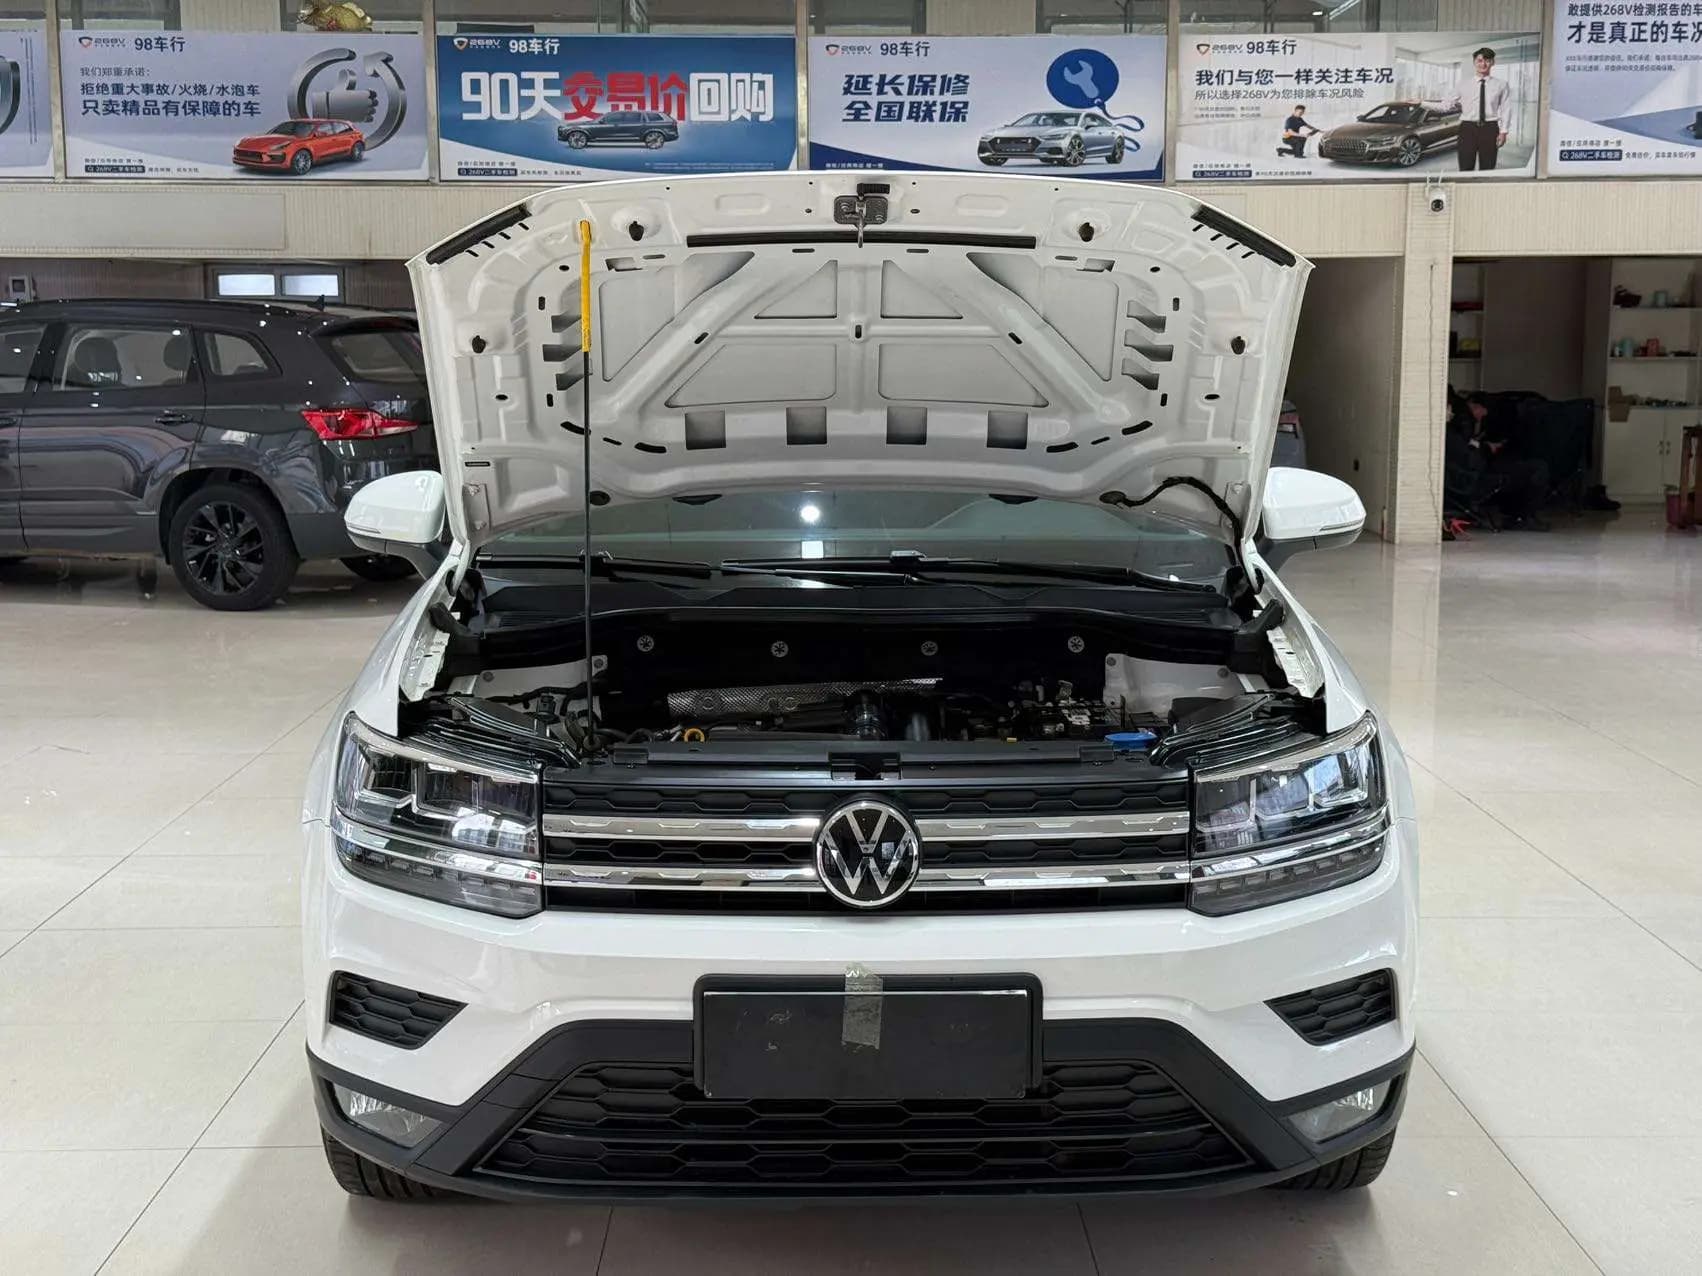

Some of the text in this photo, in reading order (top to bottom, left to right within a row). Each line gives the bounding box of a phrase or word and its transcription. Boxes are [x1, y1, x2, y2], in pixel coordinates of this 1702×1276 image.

[1567, 3, 1702, 17] 敢提供268V检测报告的车
[134, 36, 186, 52] 98车行
[509, 38, 560, 55] 98车行
[880, 41, 930, 57] 98车行
[1246, 40, 1297, 56] 98车行
[842, 73, 970, 96] 延长保修
[1195, 67, 1394, 86] 我们与您一样关注车况
[80, 82, 261, 97] 拒绝重大事故/火烧/水泡车
[461, 71, 775, 122] 90天交易价回购
[1195, 88, 1365, 101] 所以选择268V为您排除车况风险
[81, 99, 262, 117] 只卖精品有保障的车
[842, 100, 970, 123] 全国联保
